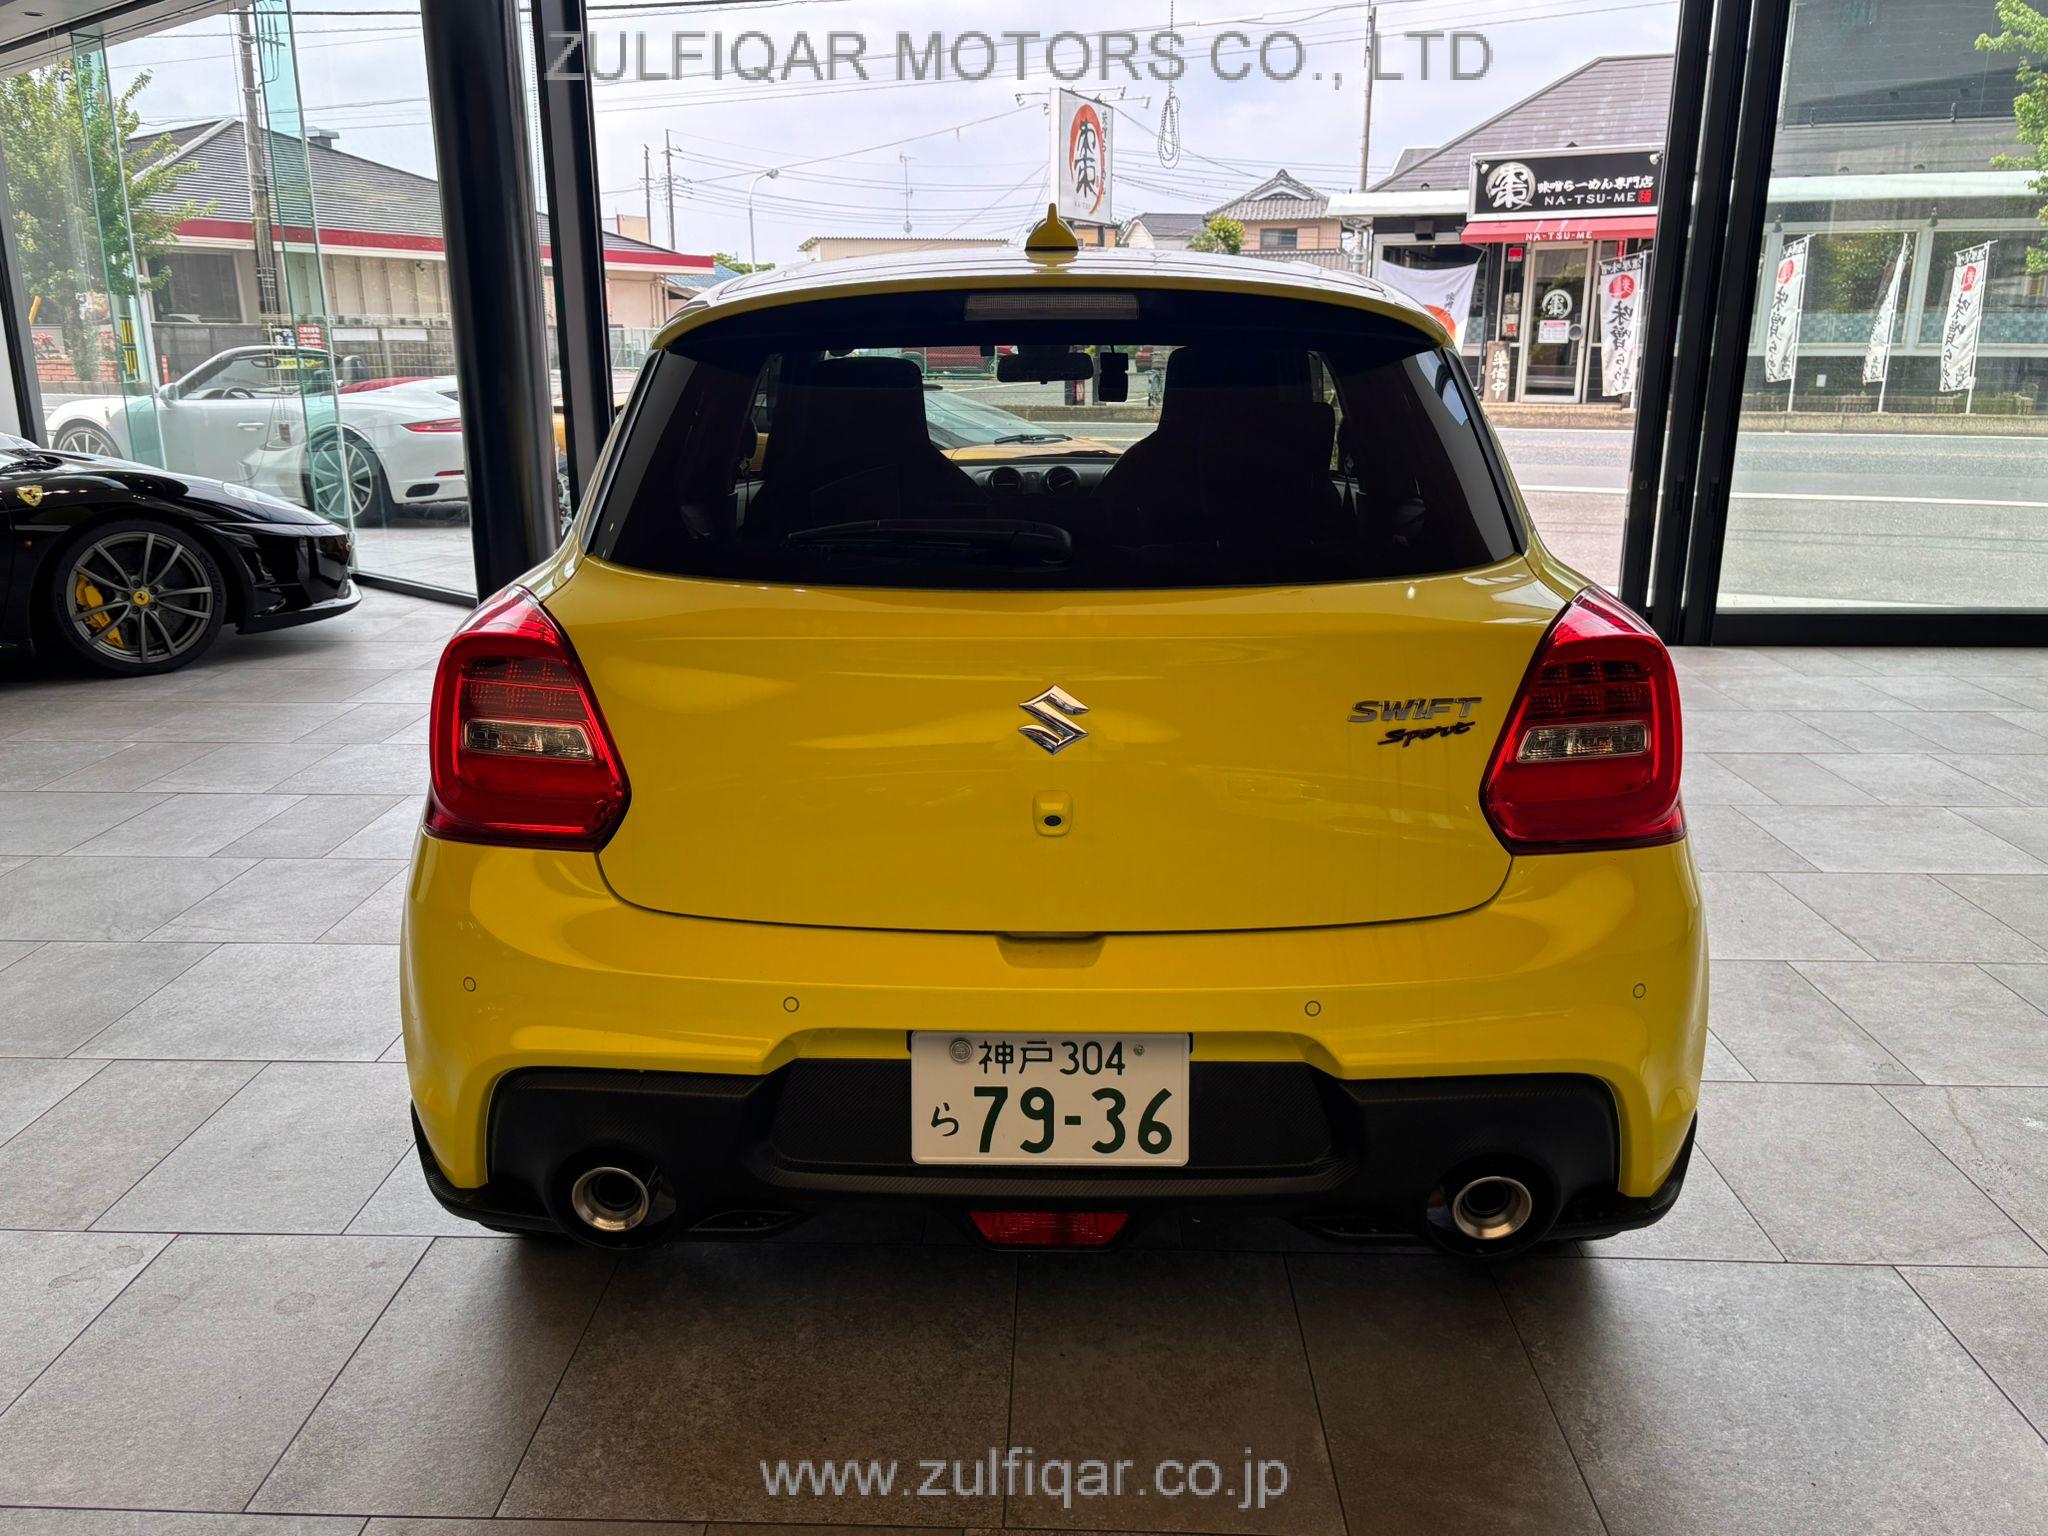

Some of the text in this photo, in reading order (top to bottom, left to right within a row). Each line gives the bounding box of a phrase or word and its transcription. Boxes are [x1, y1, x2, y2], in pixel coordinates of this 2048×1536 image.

[1544, 191, 1636, 206] NA-TSU-ME
[1525, 231, 1593, 241] NA-TSU-ME
[1490, 350, 1509, 399] 準備中
[1348, 697, 1482, 723] SWIFT
[1377, 721, 1476, 748] Sport
[978, 1040, 1053, 1075] 神戸
[1059, 1041, 1126, 1076] 304
[930, 1086, 1173, 1155] ら 79-36
